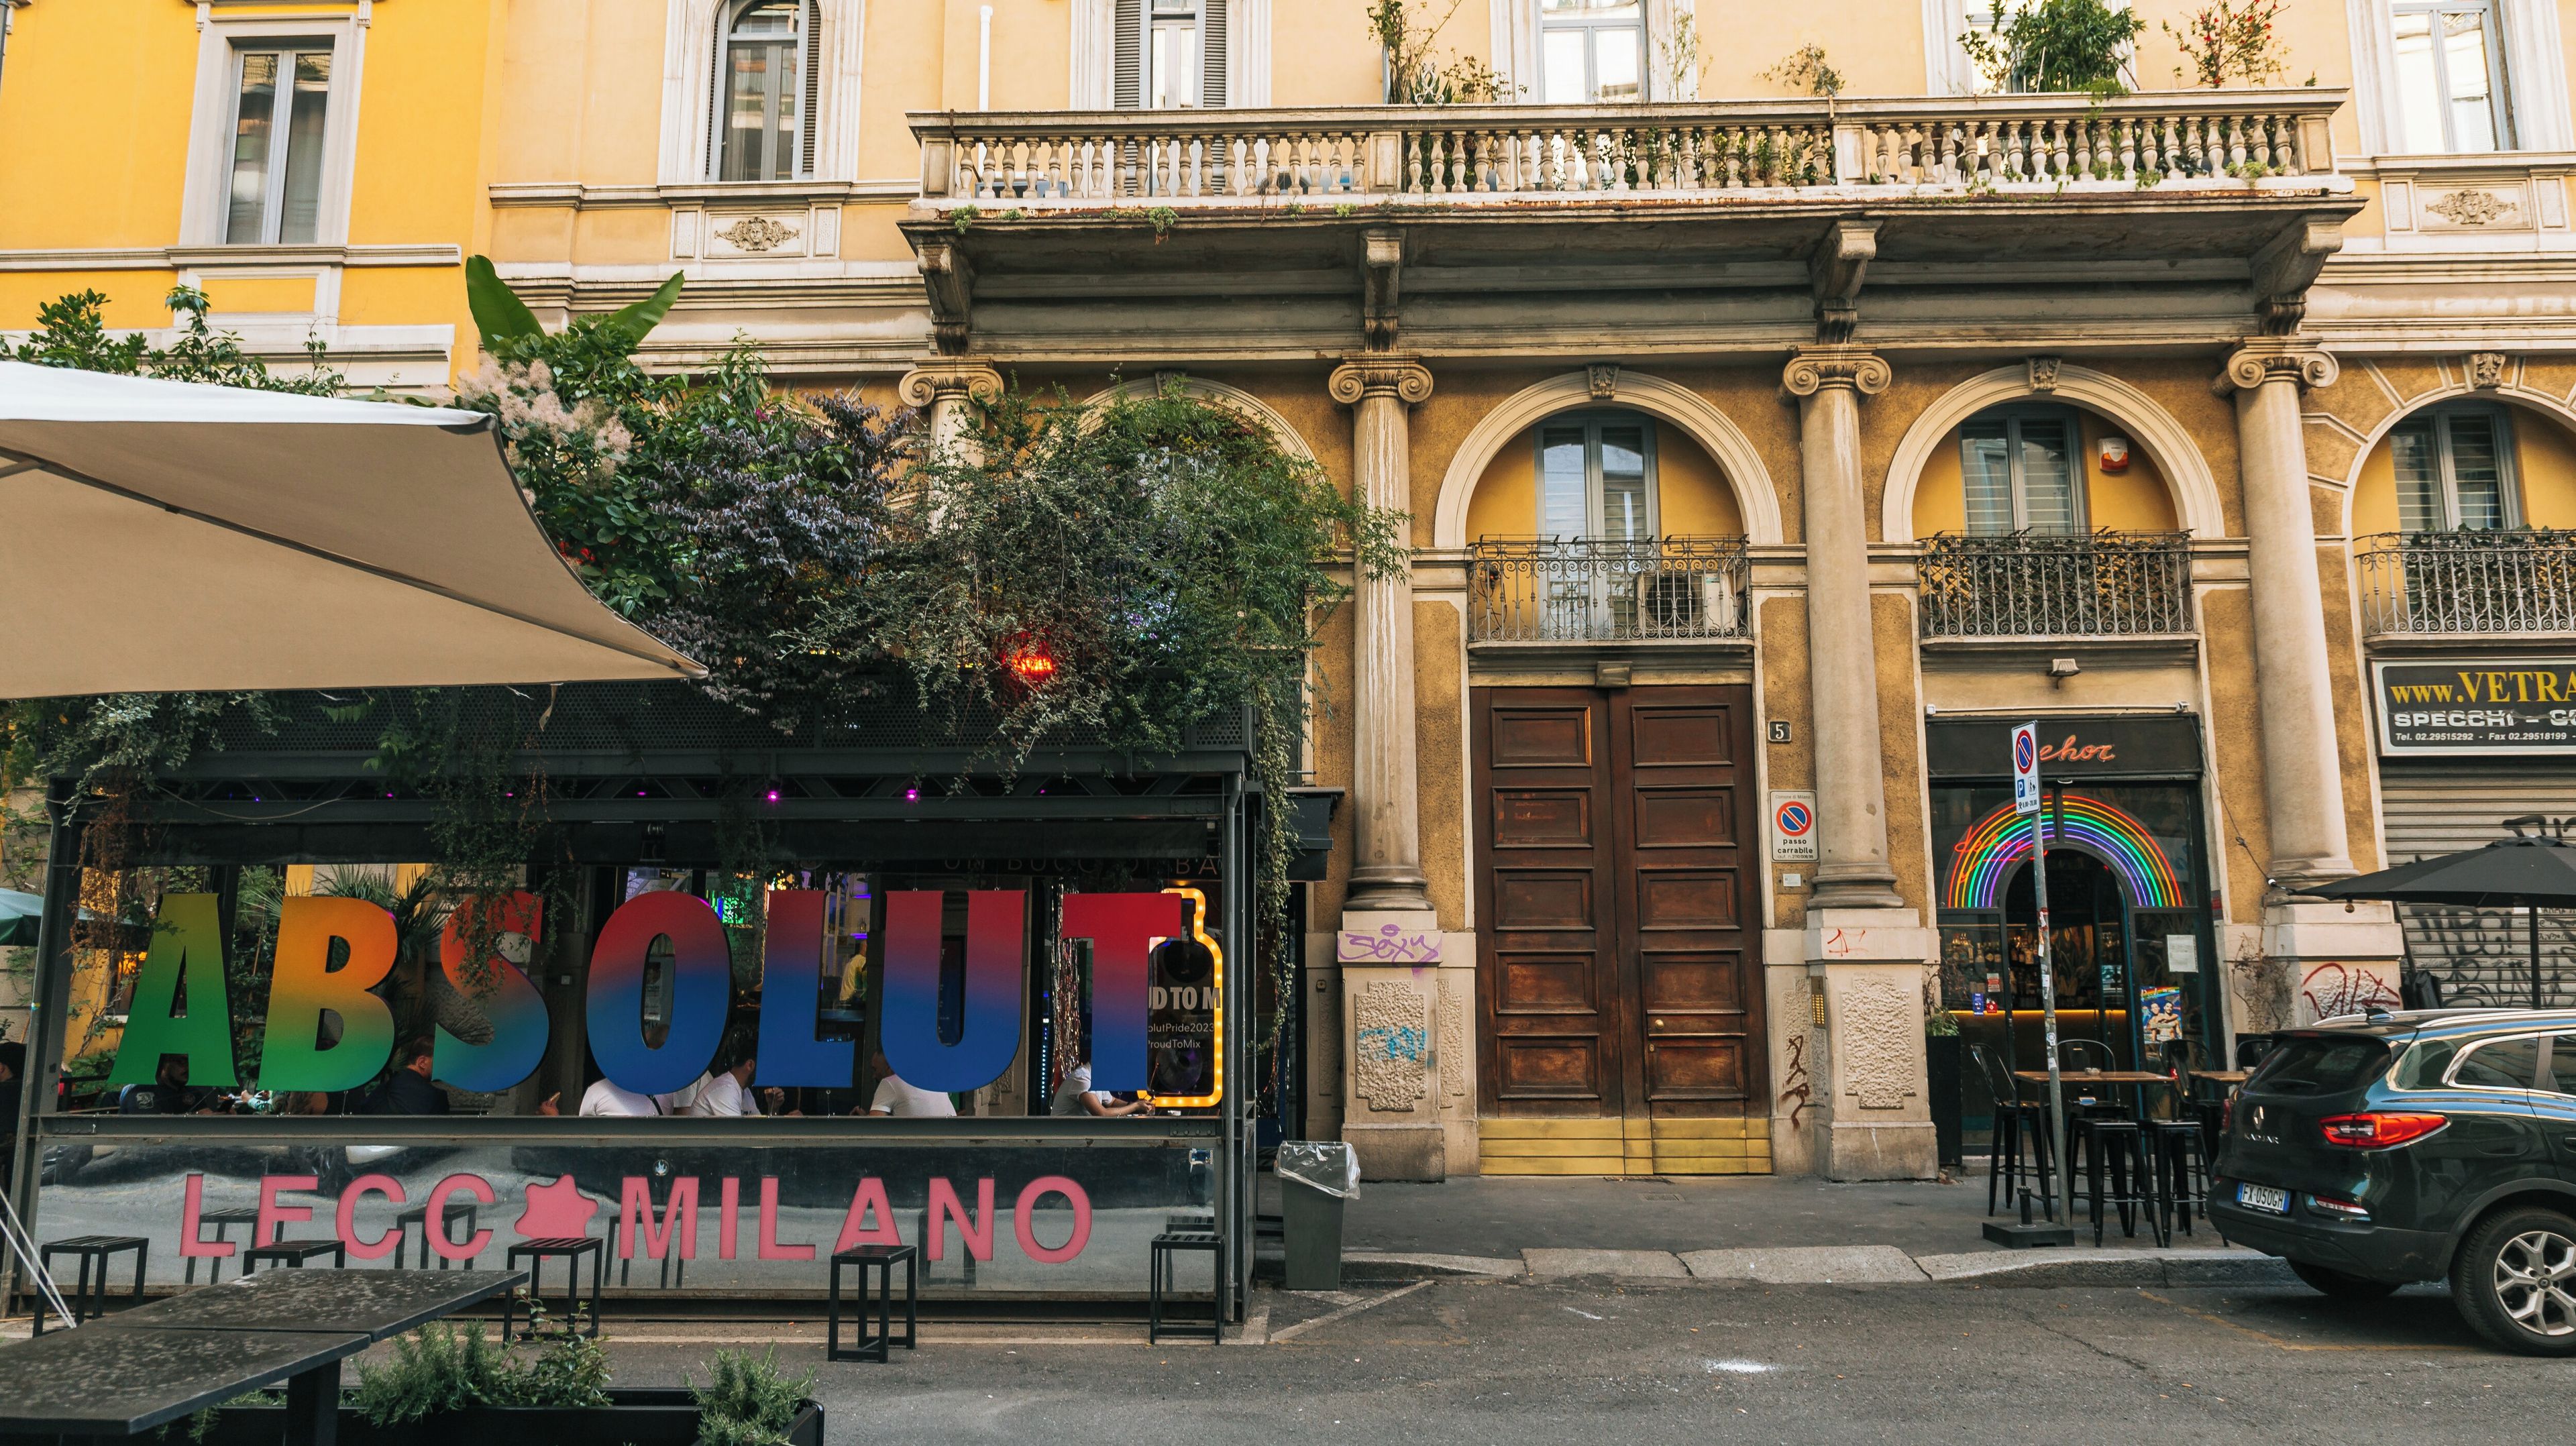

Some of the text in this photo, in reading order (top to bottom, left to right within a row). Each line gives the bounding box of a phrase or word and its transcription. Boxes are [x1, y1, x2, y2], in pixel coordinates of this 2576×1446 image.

[2394, 710, 2514, 726] SPECCHI
[1776, 724, 1784, 739] 5
[2416, 732, 2474, 740] 02.29515292
[2489, 732, 2506, 740] Fax
[2508, 732, 2567, 740] 02.29518199
[2039, 734, 2115, 763] ehor
[109, 889, 1182, 1095] ABSOLUT
[1170, 986, 1197, 1010] TO
[1148, 1040, 1201, 1048] roudToMix
[619, 1174, 1093, 1264] MILANO
